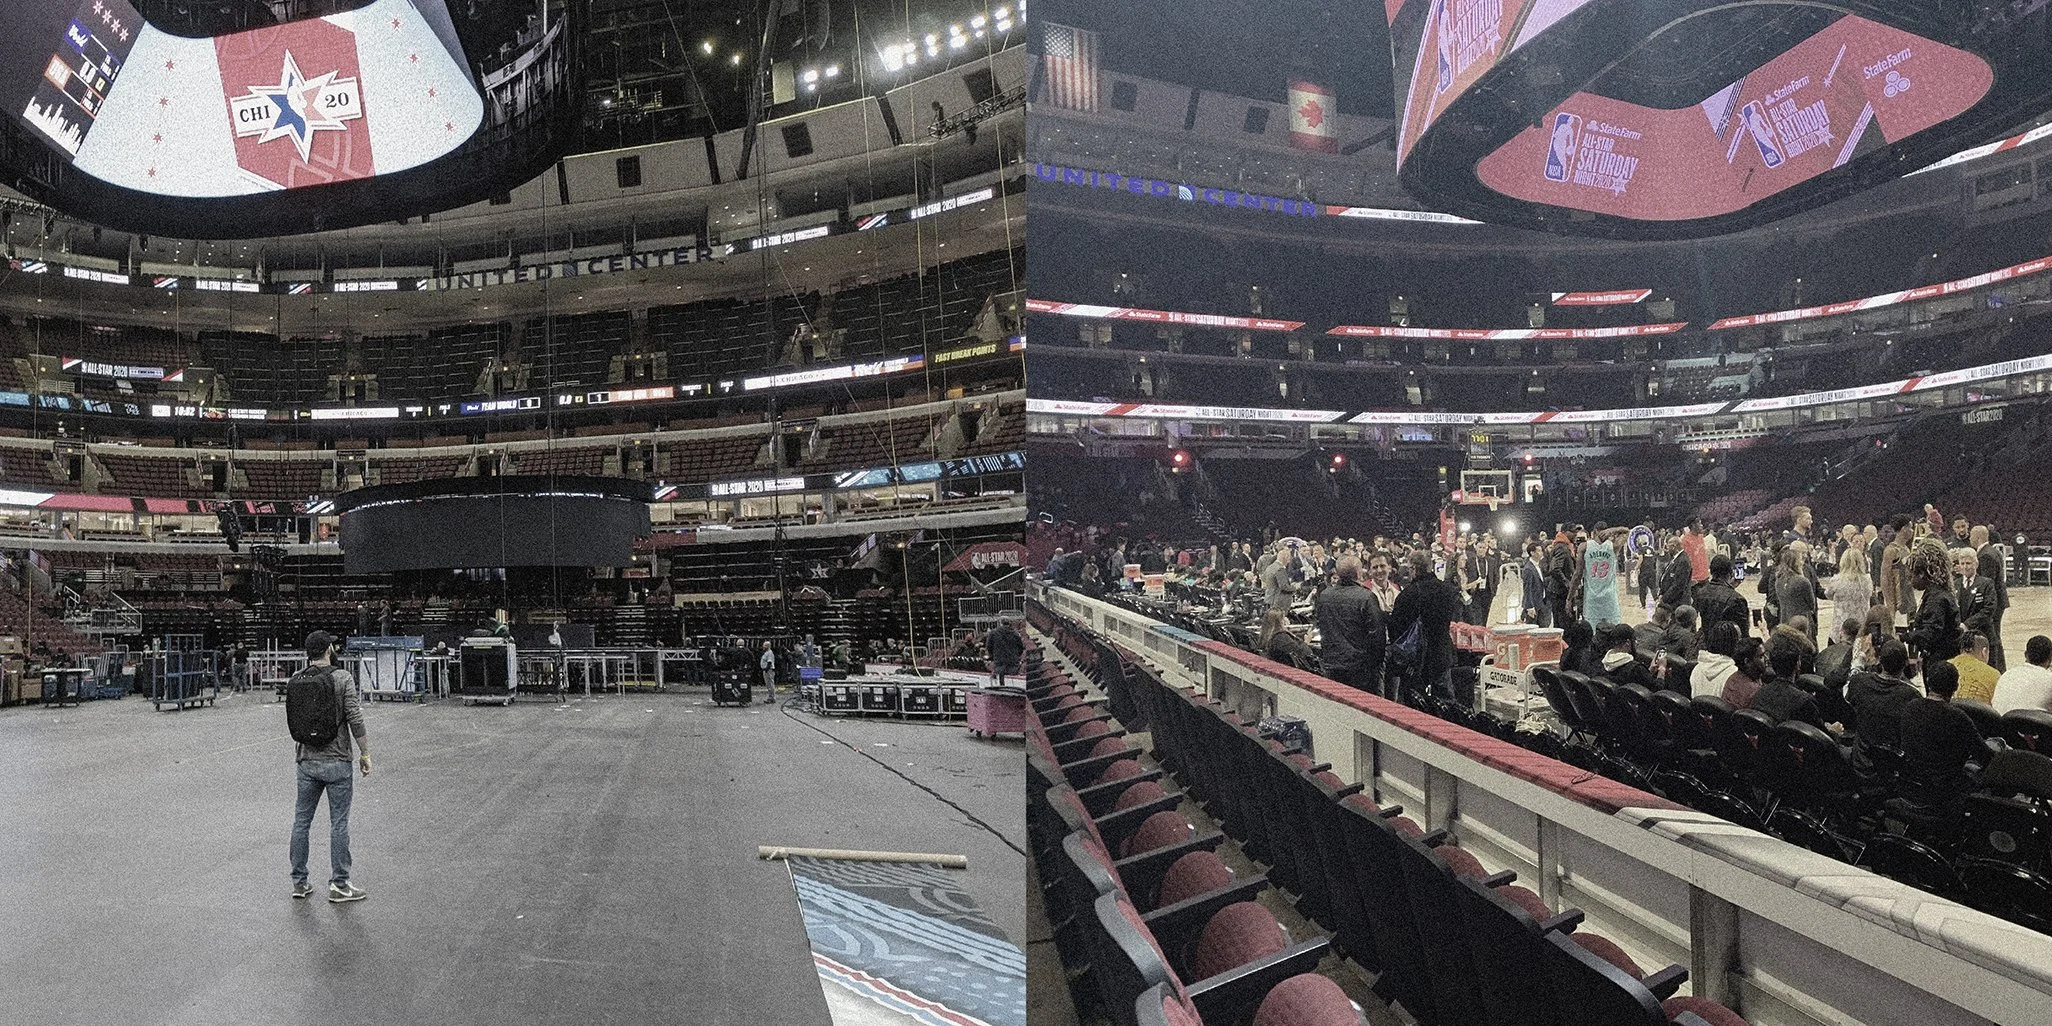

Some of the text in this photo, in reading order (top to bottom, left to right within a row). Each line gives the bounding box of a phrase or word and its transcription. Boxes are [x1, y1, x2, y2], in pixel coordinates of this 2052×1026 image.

[239, 92, 350, 122] CHI 20
[1775, 99, 1831, 145] SATURDAY
[1581, 133, 1615, 152] ALL-STAR
[1577, 147, 1640, 180] SATURDAY
[1573, 169, 1597, 187] NIGHT
[1036, 162, 1317, 218] UNITED CENTER
[917, 202, 941, 217] ALL-STAR
[438, 246, 714, 292] UNITED CENTER
[1195, 314, 1225, 326] SATURDAY
[935, 344, 997, 363] FAST BREAK POINTS
[87, 362, 113, 376] ALL-STAR
[113, 365, 128, 378] 2020
[1990, 362, 2021, 376] SATURDAY
[497, 399, 517, 410] WORLD
[1202, 409, 1226, 418] ALL-STAR
[1225, 409, 1257, 420] SATURDAY
[1257, 410, 1271, 419] NIGHT
[1434, 413, 1462, 424] SATURDAY
[1626, 408, 1653, 419] SATURDAY
[718, 482, 747, 495] ALL-STAR
[747, 480, 763, 493] 2020
[981, 550, 1019, 564] ALL-STAR 2020
[1590, 560, 1612, 579] 13
[1490, 670, 1518, 687] GATORADE
